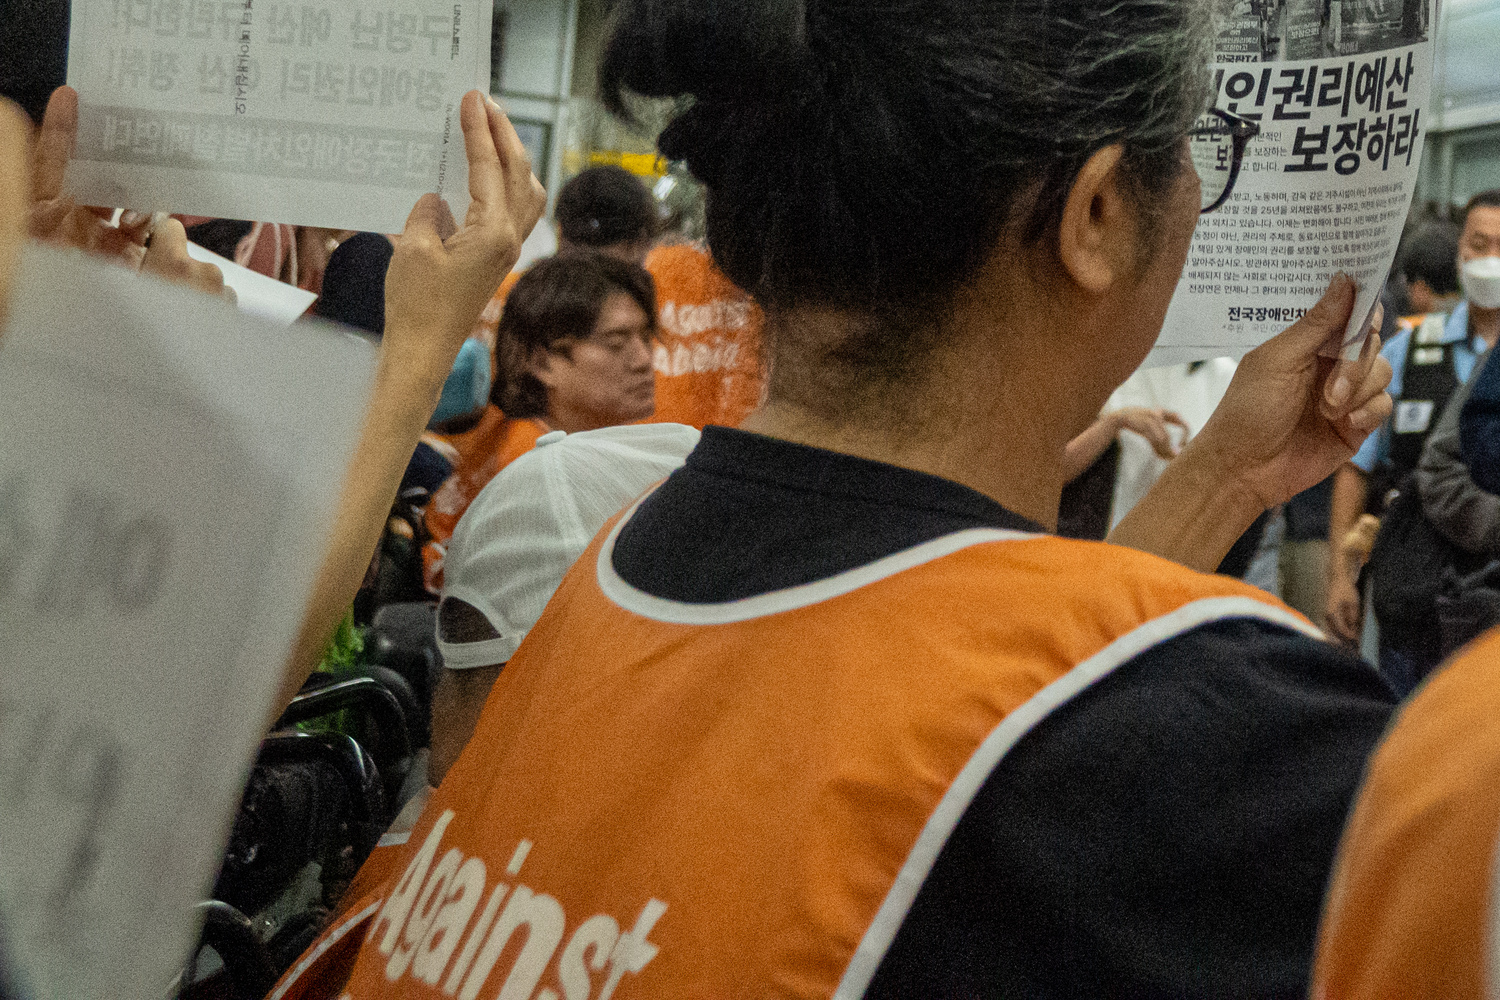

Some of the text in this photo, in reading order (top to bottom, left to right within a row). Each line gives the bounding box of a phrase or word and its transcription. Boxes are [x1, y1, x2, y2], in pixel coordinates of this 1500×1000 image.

[1216, 51, 1414, 120] 인권리예산
[1283, 108, 1422, 176] 보장하라
[1242, 206, 1258, 215] 것을
[1239, 218, 1274, 228] 있습니다.
[1216, 245, 1232, 254] 있게
[1192, 258, 1243, 267] 말아주십시오.
[367, 808, 671, 999] Against
